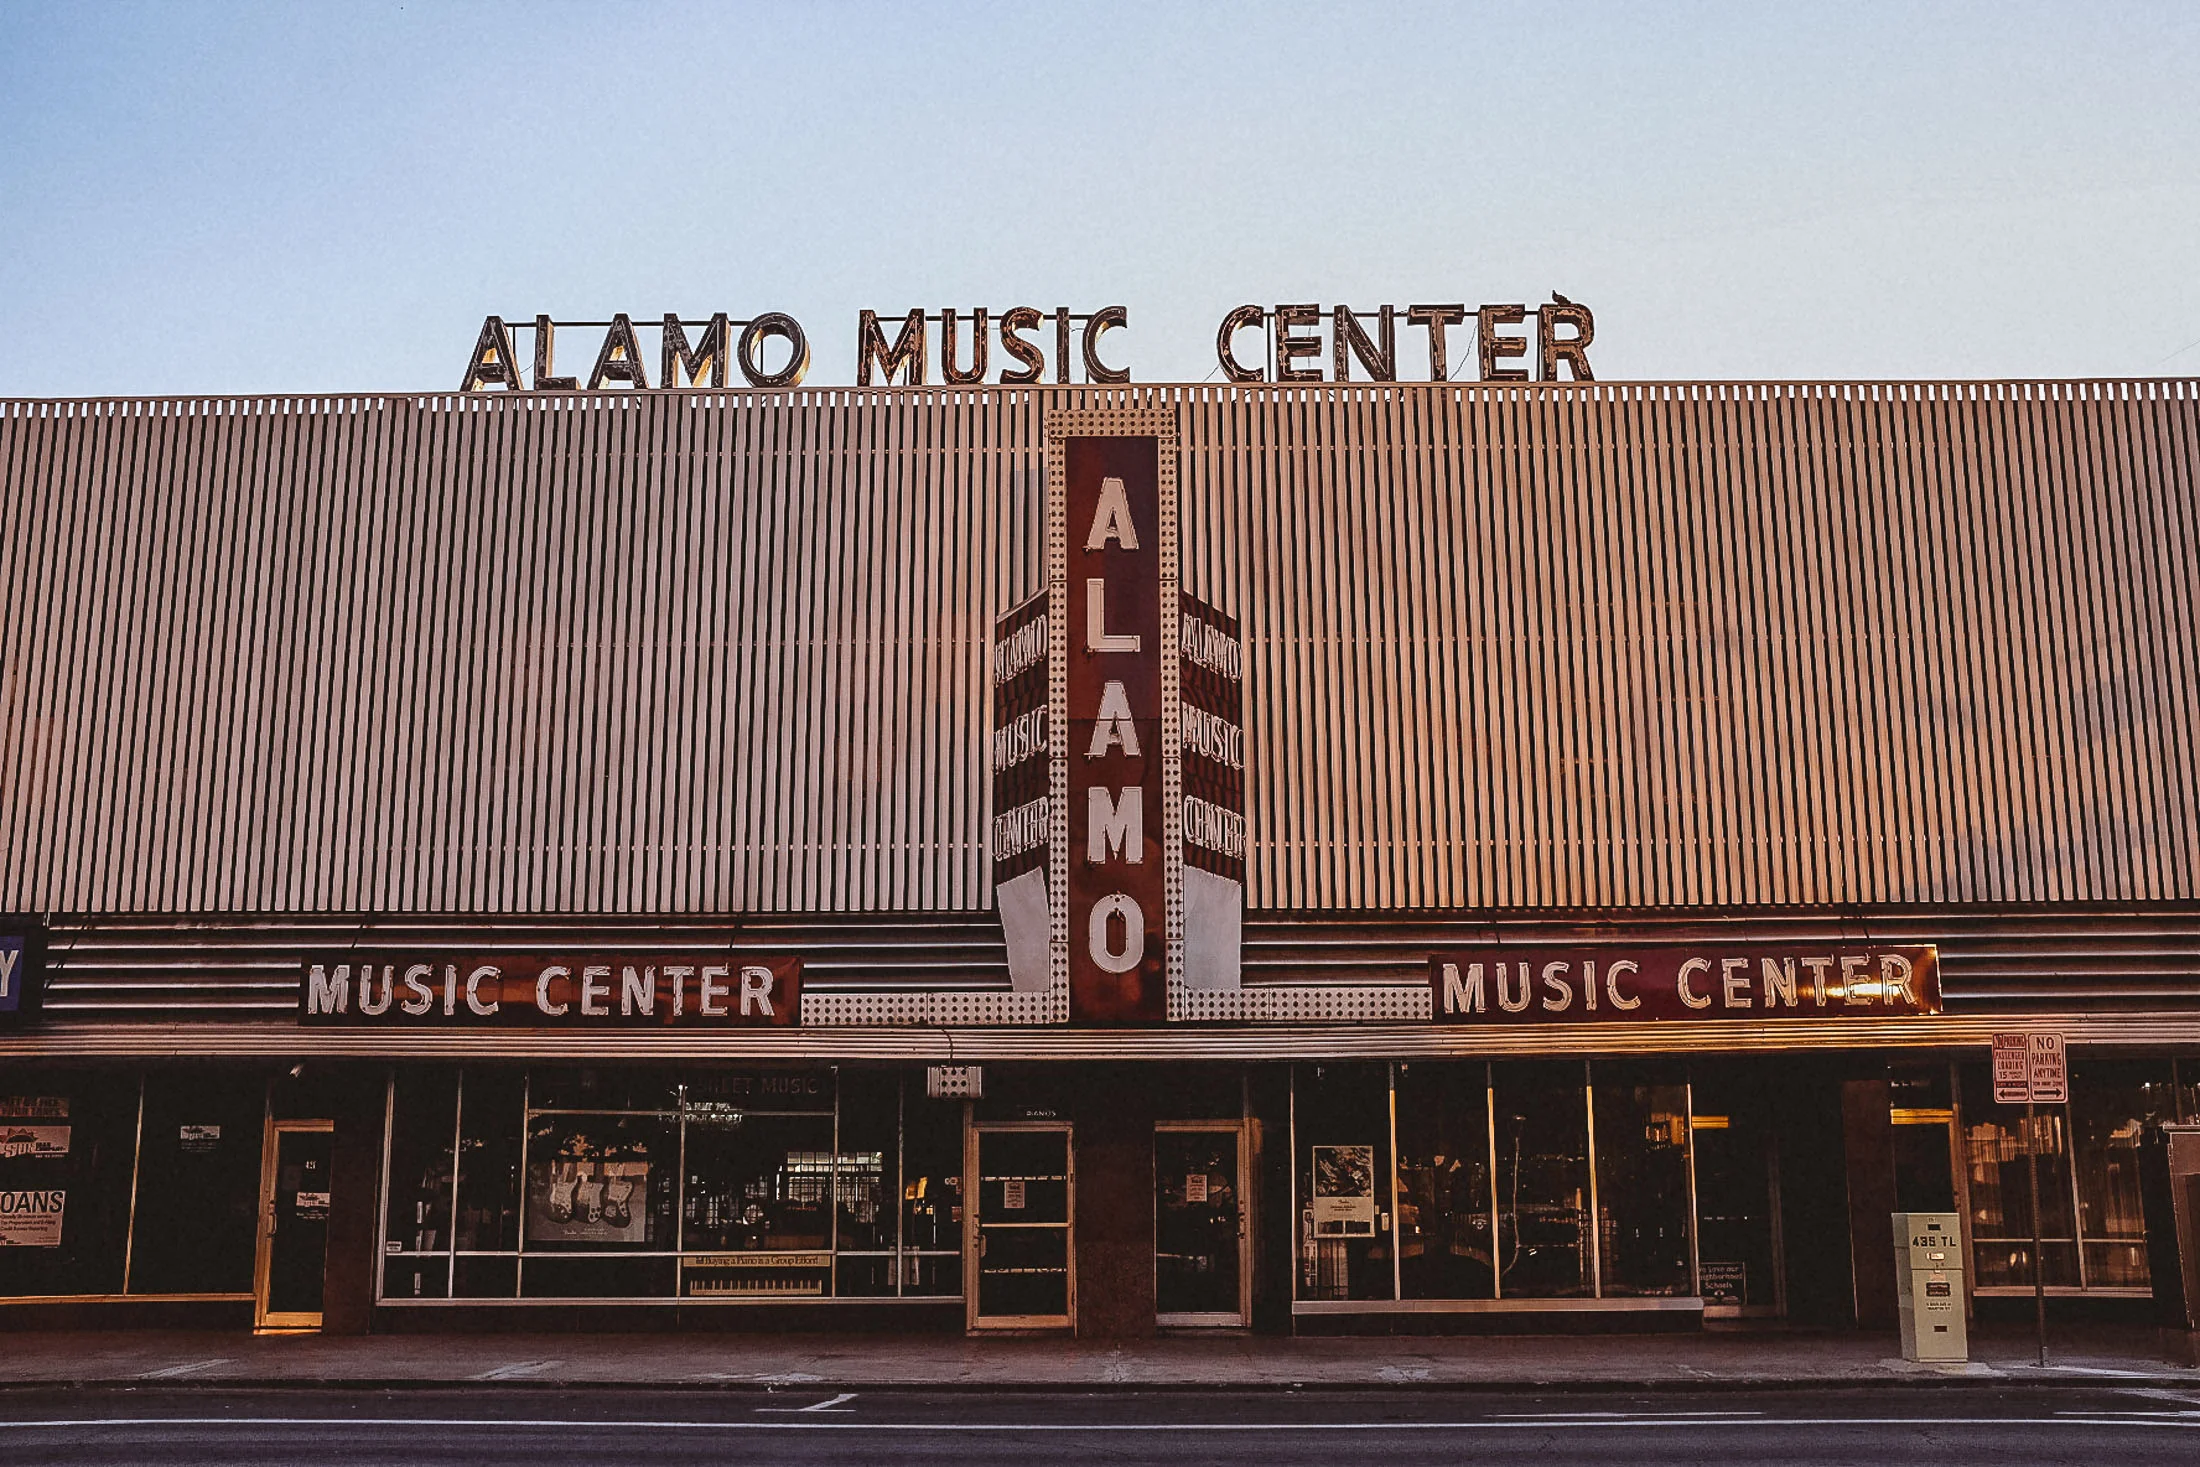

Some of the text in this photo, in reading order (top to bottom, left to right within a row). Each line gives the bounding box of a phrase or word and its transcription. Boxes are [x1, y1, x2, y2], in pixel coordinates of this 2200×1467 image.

[459, 303, 1595, 391] ALAMO MUSIC CENTER
[993, 614, 1048, 687] ALAMO
[1181, 611, 1242, 684] ALAMO
[992, 704, 1048, 775] MUSIC
[1084, 476, 1145, 975] ALAMO
[1181, 700, 1245, 771] MUSIC
[991, 796, 1049, 862] CENTER
[1183, 794, 1247, 861] CENTER
[306, 962, 776, 1017] MUSIC CENTER
[1442, 953, 1917, 1015] MUSIC CENTER
[1996, 1051, 2024, 1060] PASSENGER
[1998, 1061, 2024, 1069] LOADING
[2032, 1052, 2062, 1065] PARKING
[2036, 1036, 2054, 1050] NO
[1999, 1071, 2008, 1079] 15
[2034, 1067, 2061, 1078] ANYTIME
[771, 1256, 795, 1267] Group
[1941, 1236, 1956, 1247] TL
